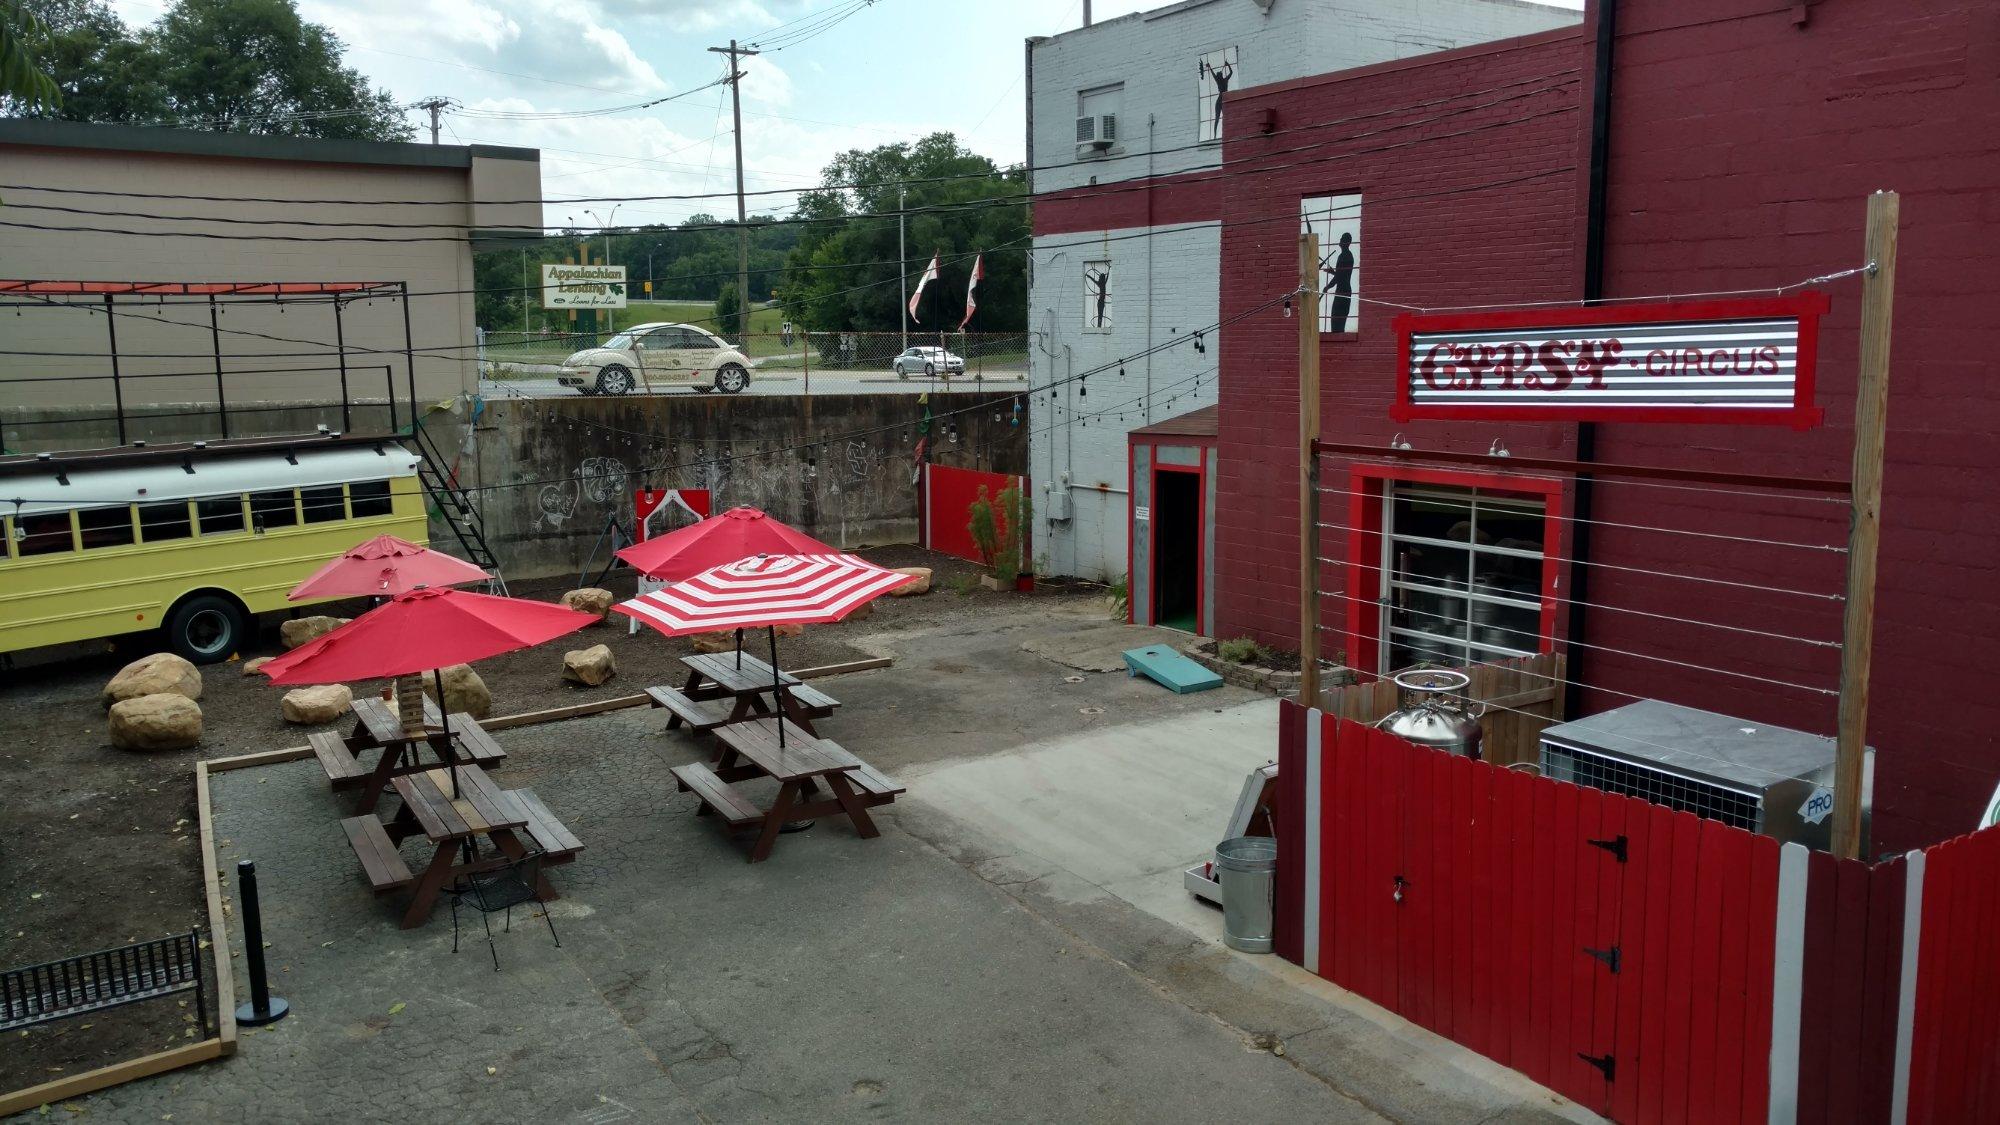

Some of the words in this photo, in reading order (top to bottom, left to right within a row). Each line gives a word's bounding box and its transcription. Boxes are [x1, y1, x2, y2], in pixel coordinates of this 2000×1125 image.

[548, 267, 622, 280] Appalachian
[558, 281, 607, 295] Lending
[568, 296, 590, 305] Loans
[590, 296, 600, 306] for
[1420, 338, 1624, 392] GYPSY
[1645, 345, 1781, 377] CIRCUS
[1807, 793, 1833, 817] PRO
